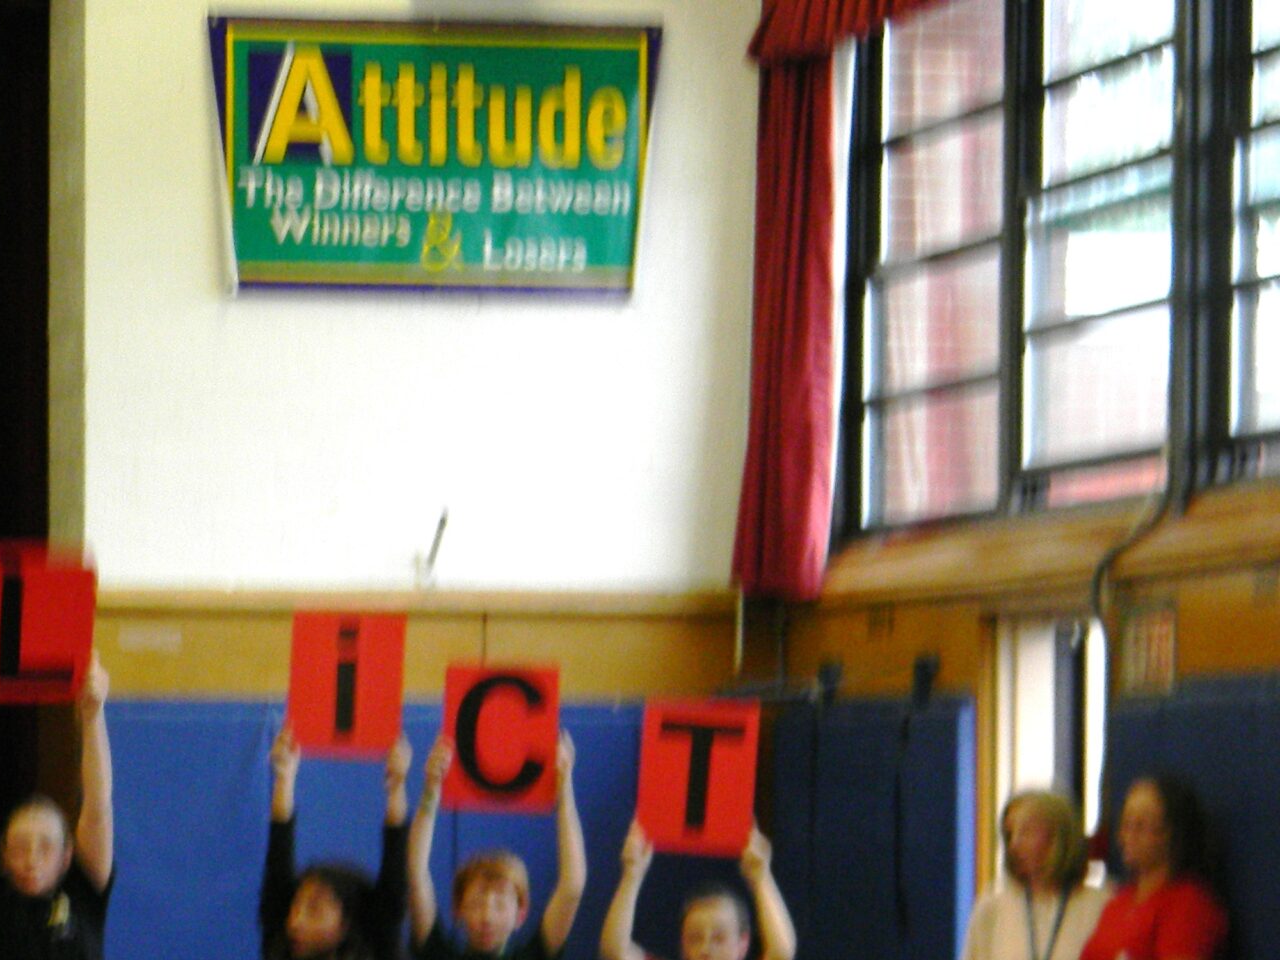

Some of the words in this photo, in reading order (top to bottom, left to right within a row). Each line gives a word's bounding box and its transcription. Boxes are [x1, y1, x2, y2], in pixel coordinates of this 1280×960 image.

[252, 41, 627, 170] Attitude
[239, 166, 303, 211] The
[315, 168, 481, 214] Difference
[492, 171, 630, 217] Between
[270, 209, 410, 248] Winners
[421, 208, 464, 272] &
[483, 229, 587, 274] Losers
